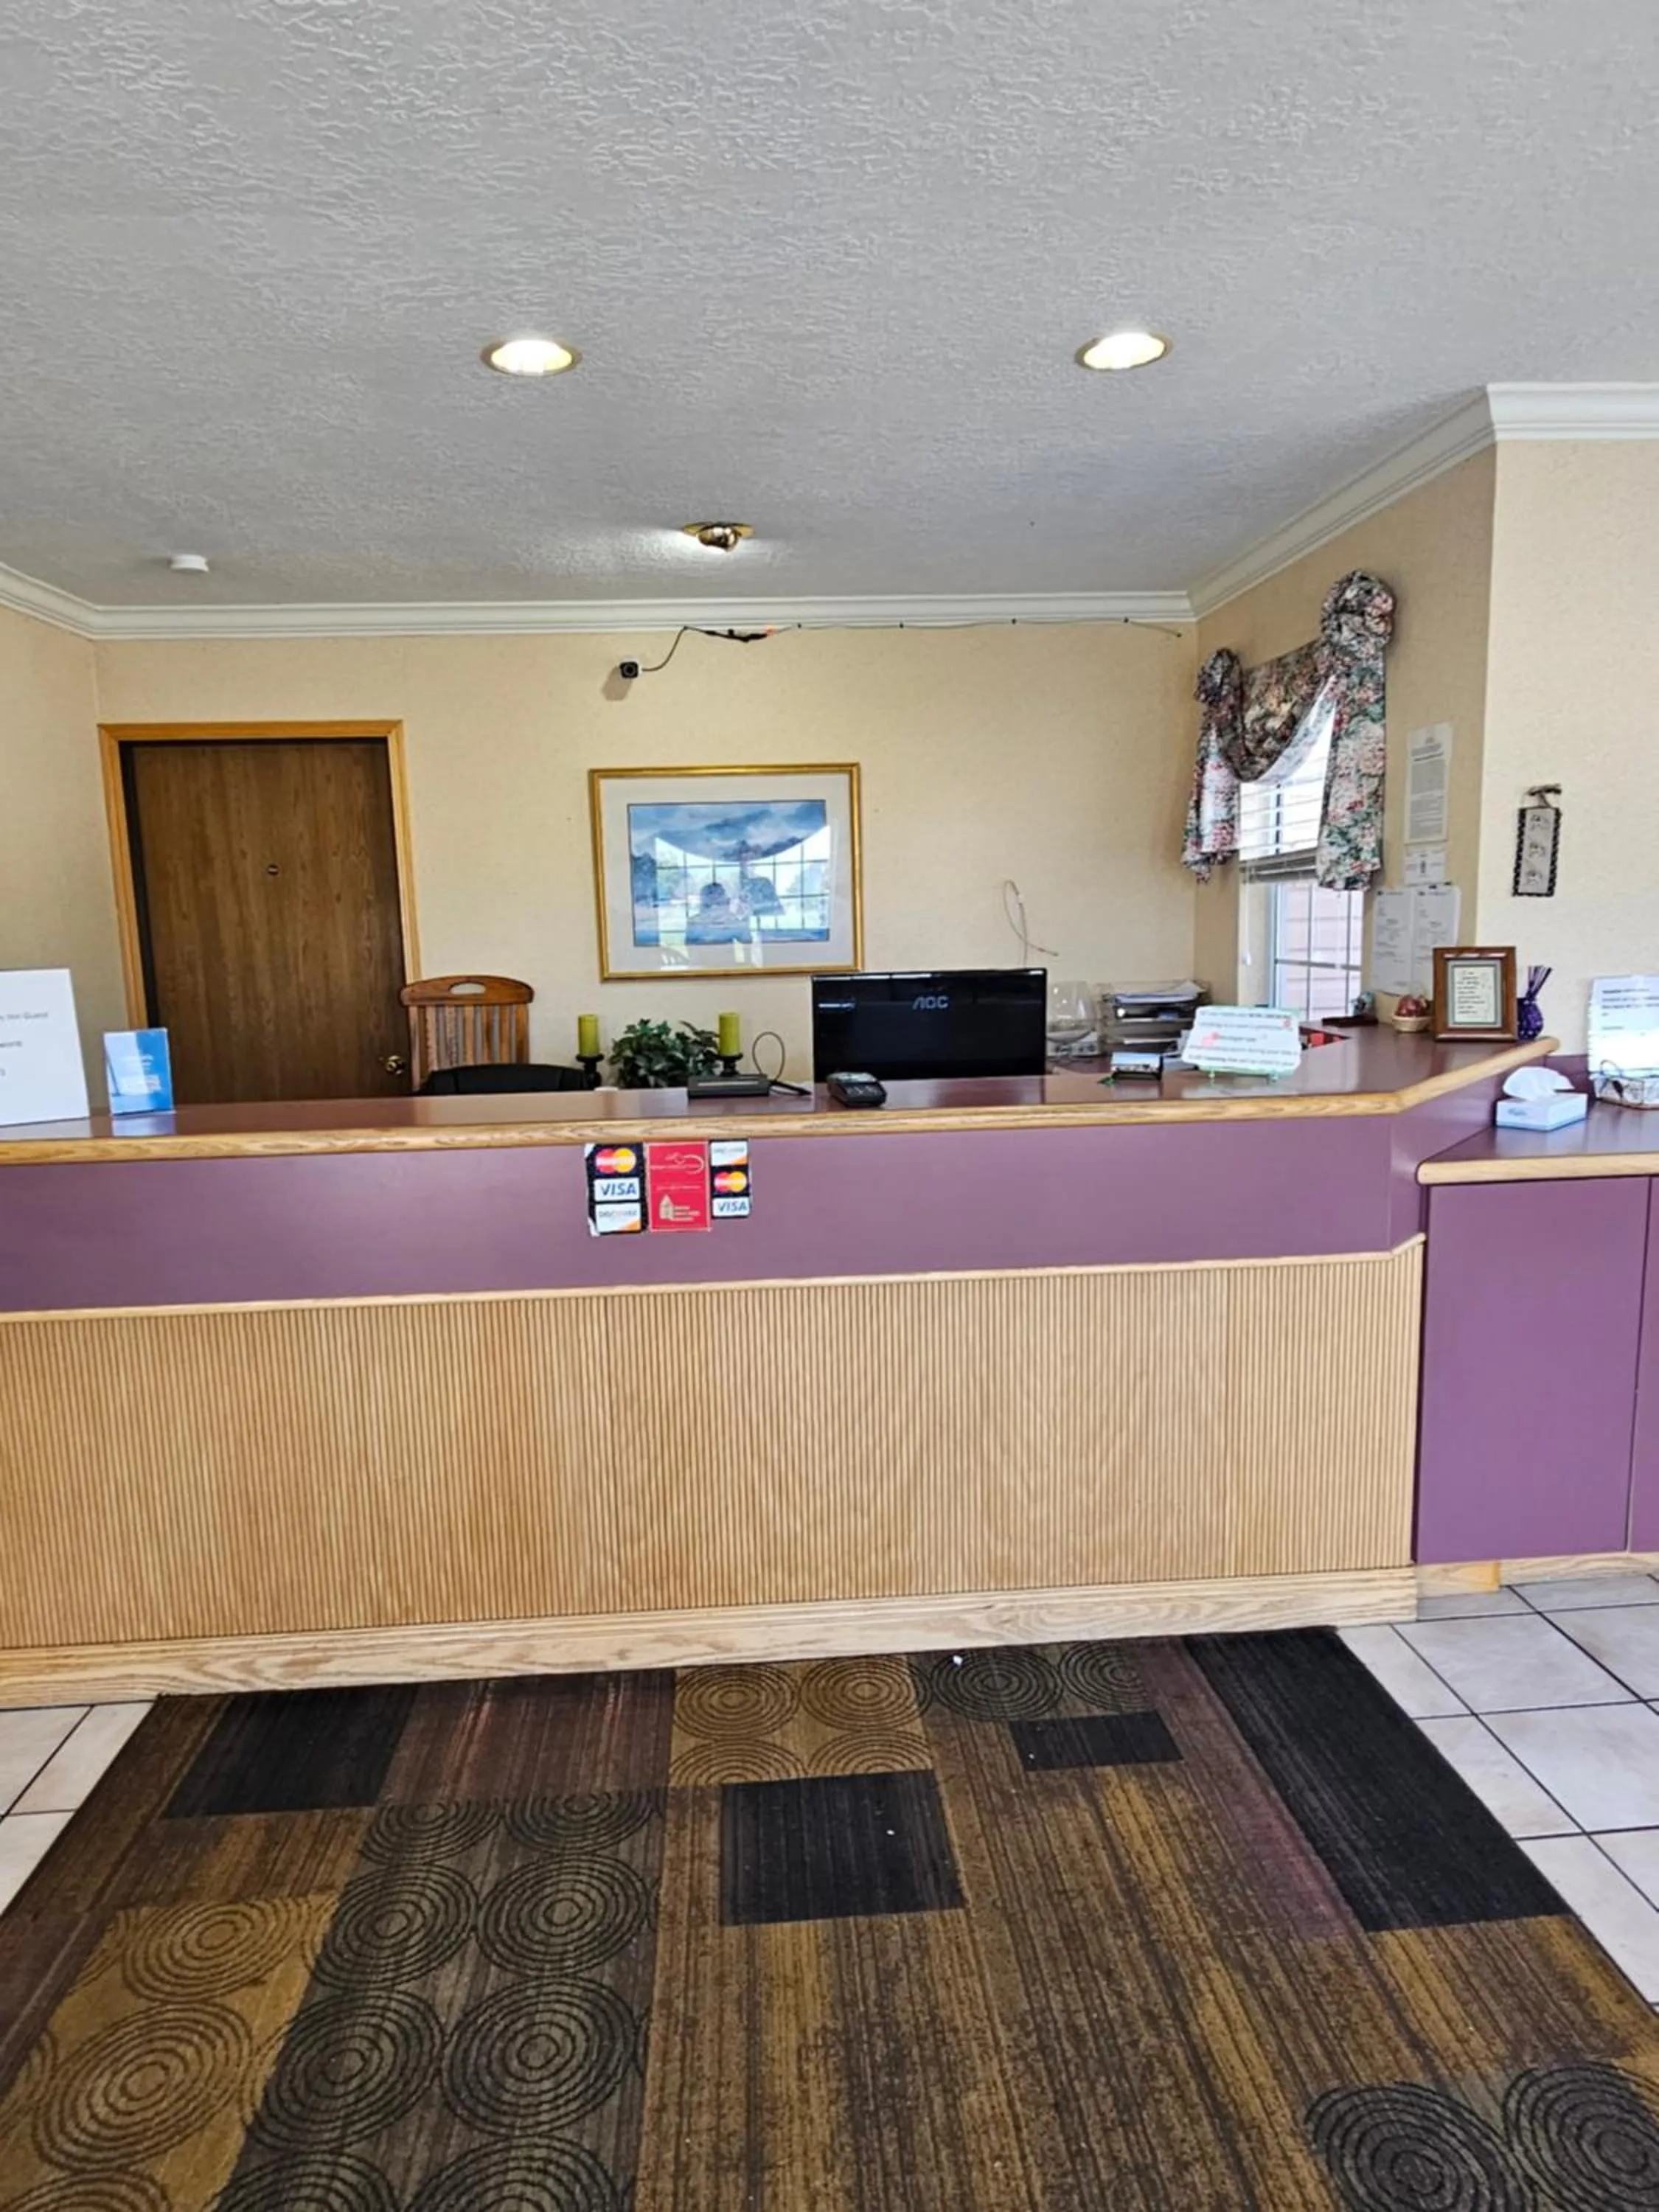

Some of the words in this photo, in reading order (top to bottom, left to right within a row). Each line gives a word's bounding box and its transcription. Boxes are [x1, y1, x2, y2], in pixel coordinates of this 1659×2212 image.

[912, 995, 949, 1009] AOC
[600, 1182, 636, 1195] VISA
[717, 1200, 747, 1212] VISA
